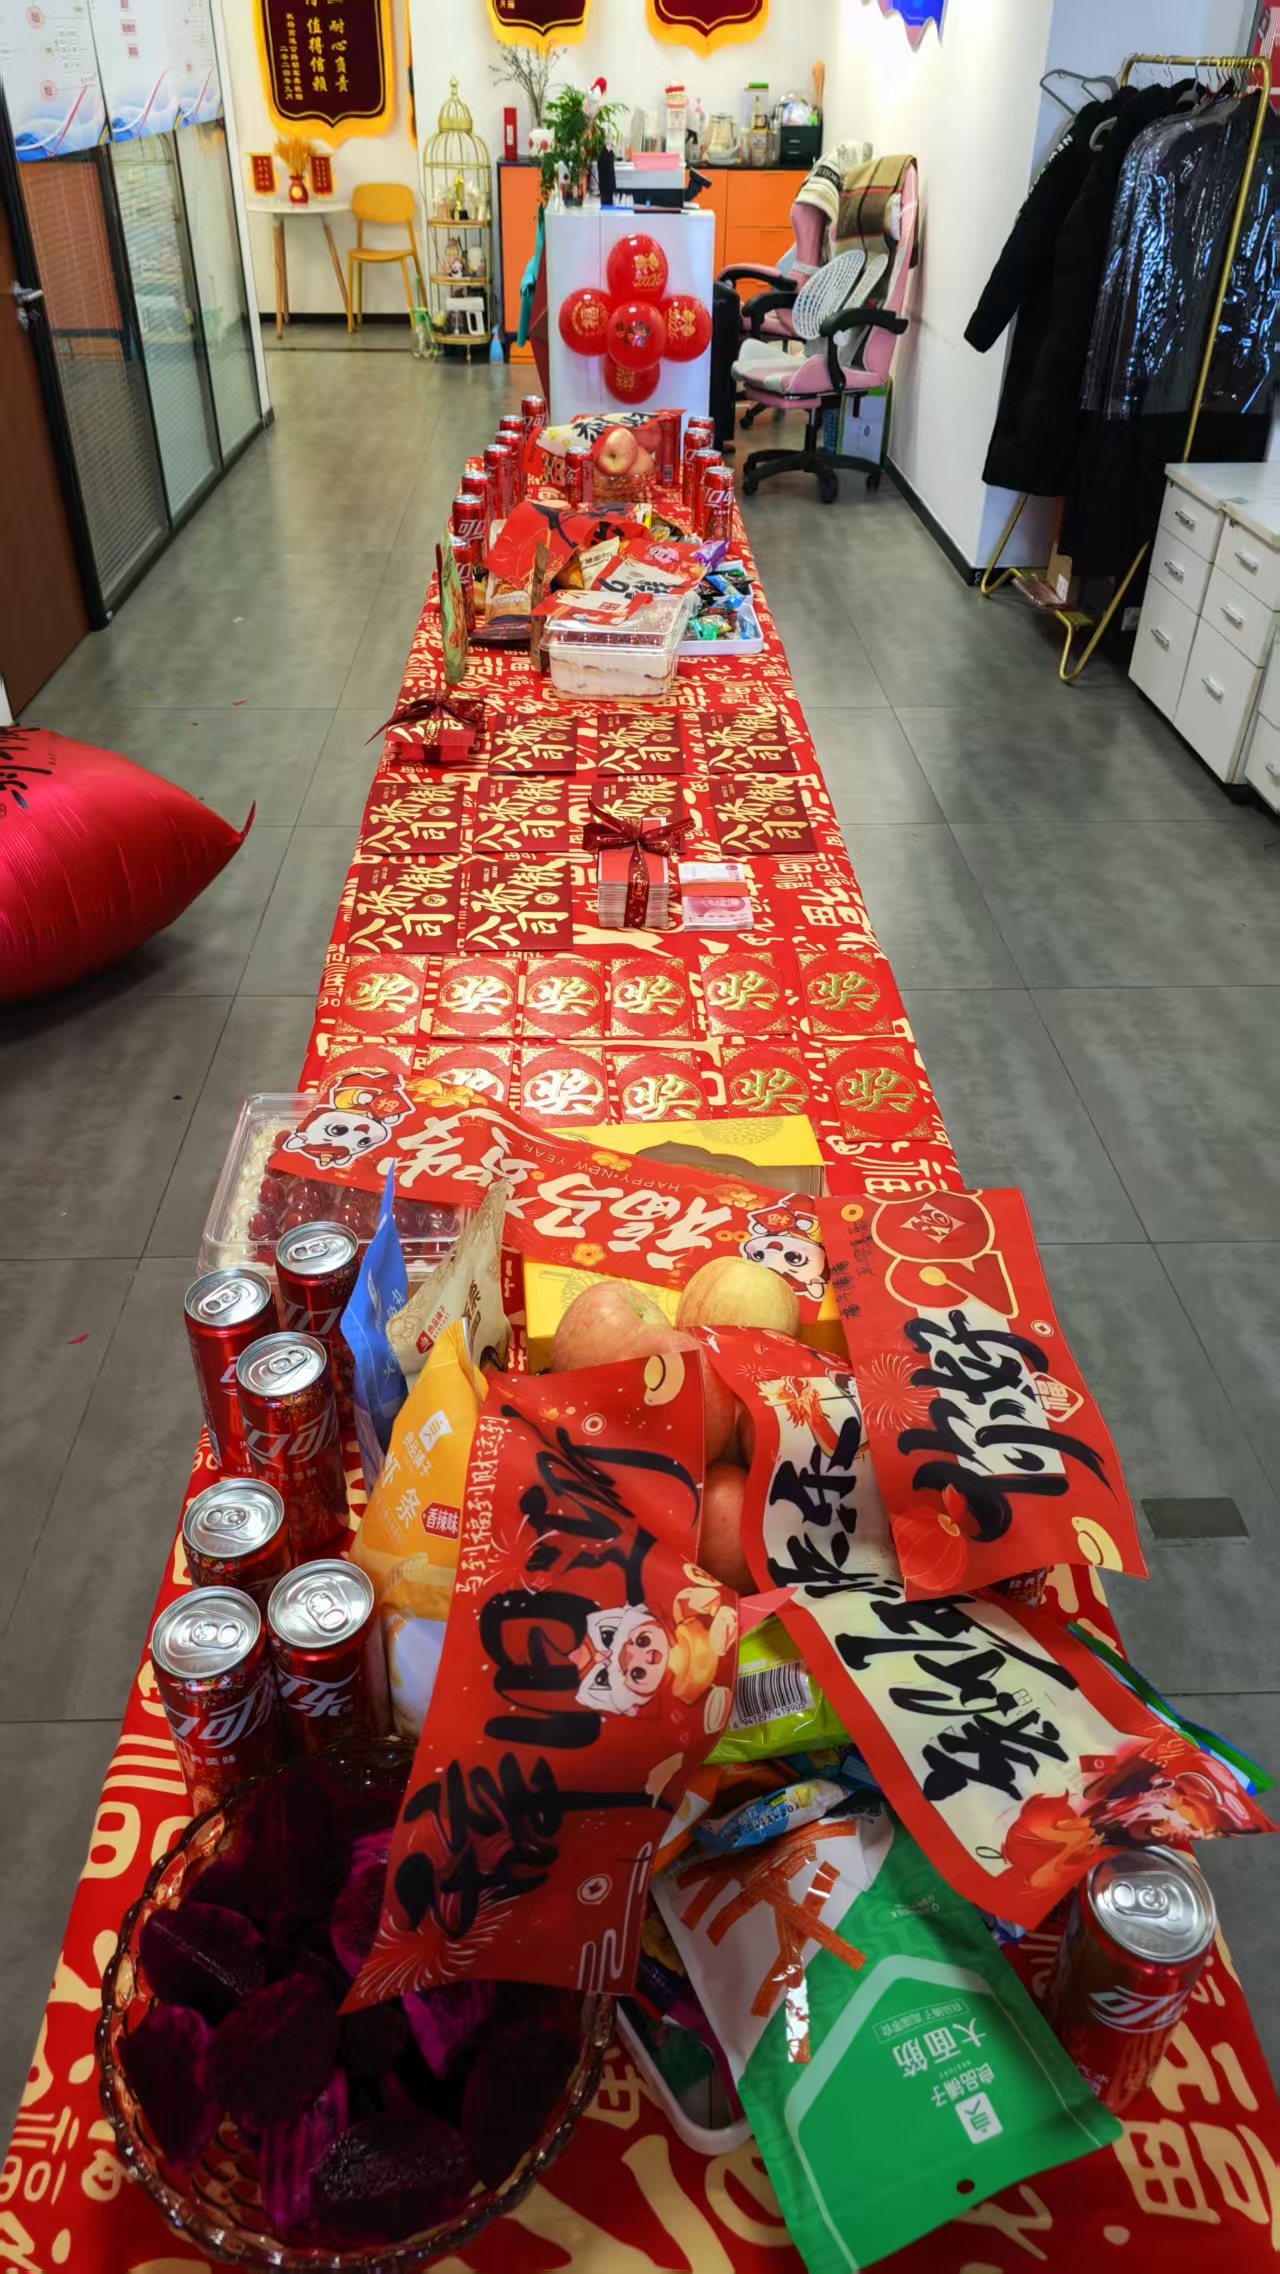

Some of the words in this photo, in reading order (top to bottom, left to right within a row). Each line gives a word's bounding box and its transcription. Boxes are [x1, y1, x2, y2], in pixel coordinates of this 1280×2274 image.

[522, 1143, 565, 1167] YEAR
[426, 1304, 448, 1335] 良品铺子
[1036, 1376, 1072, 1414] 福
[898, 1309, 1120, 1542] 你好
[426, 1507, 460, 1534] 香辣味
[456, 1415, 510, 1595] 马到福到财运到
[892, 2017, 987, 2078] 大面筋
[930, 2062, 995, 2108] 良品铺子
